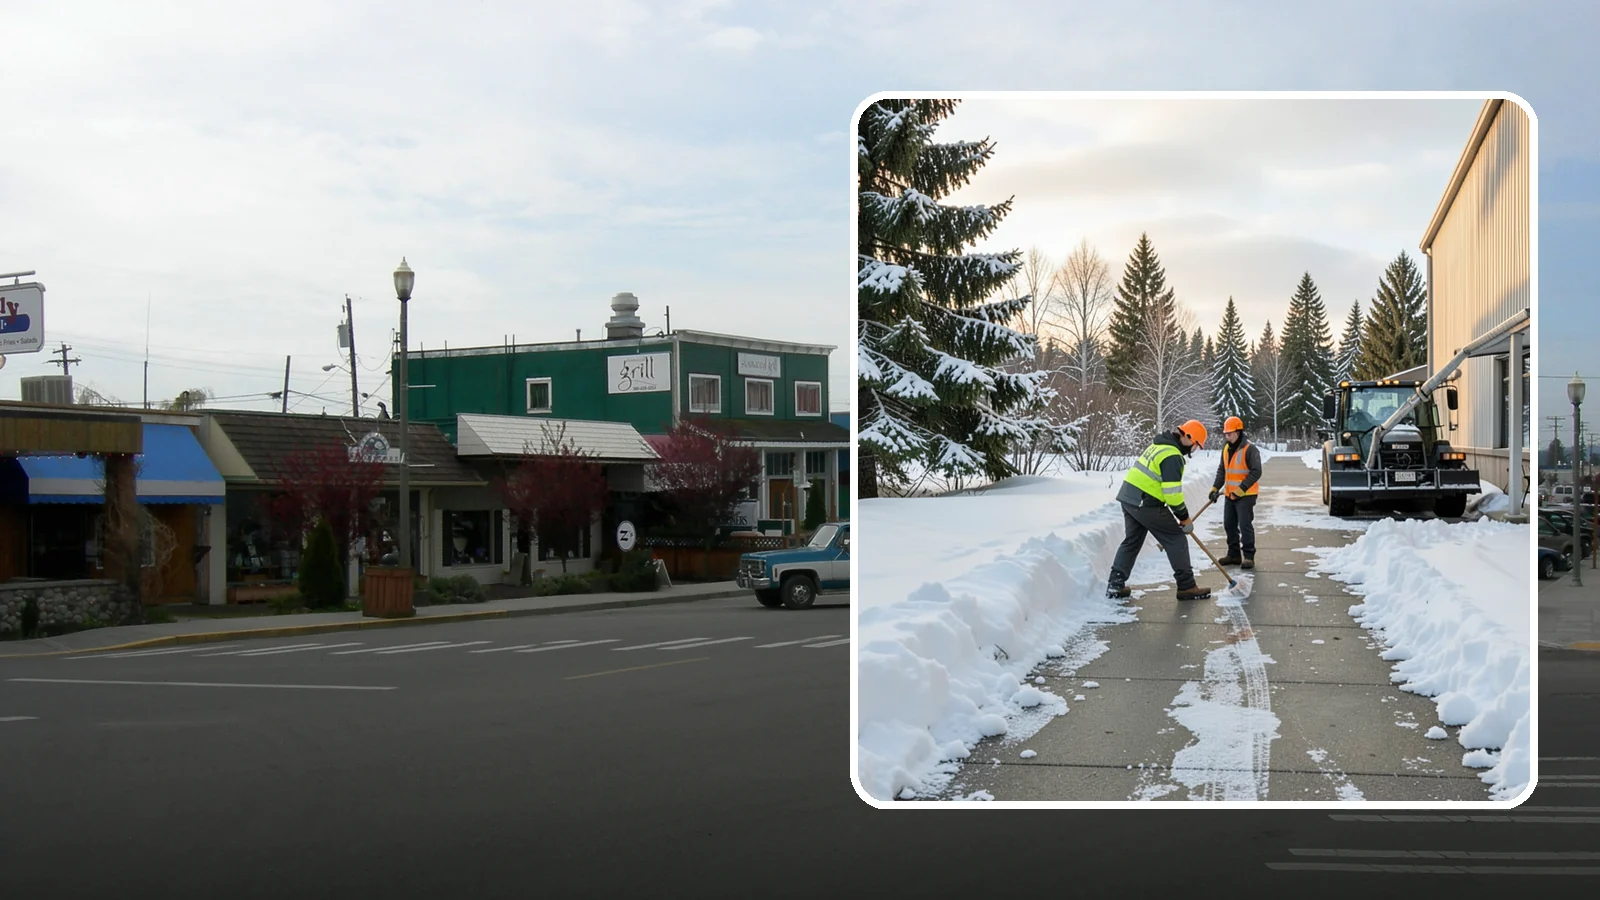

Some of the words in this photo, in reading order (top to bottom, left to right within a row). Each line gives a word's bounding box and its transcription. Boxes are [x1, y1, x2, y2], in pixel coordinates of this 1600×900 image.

[3, 338, 16, 346] Fries
[21, 337, 38, 345] Salads
[618, 355, 655, 392] grill
